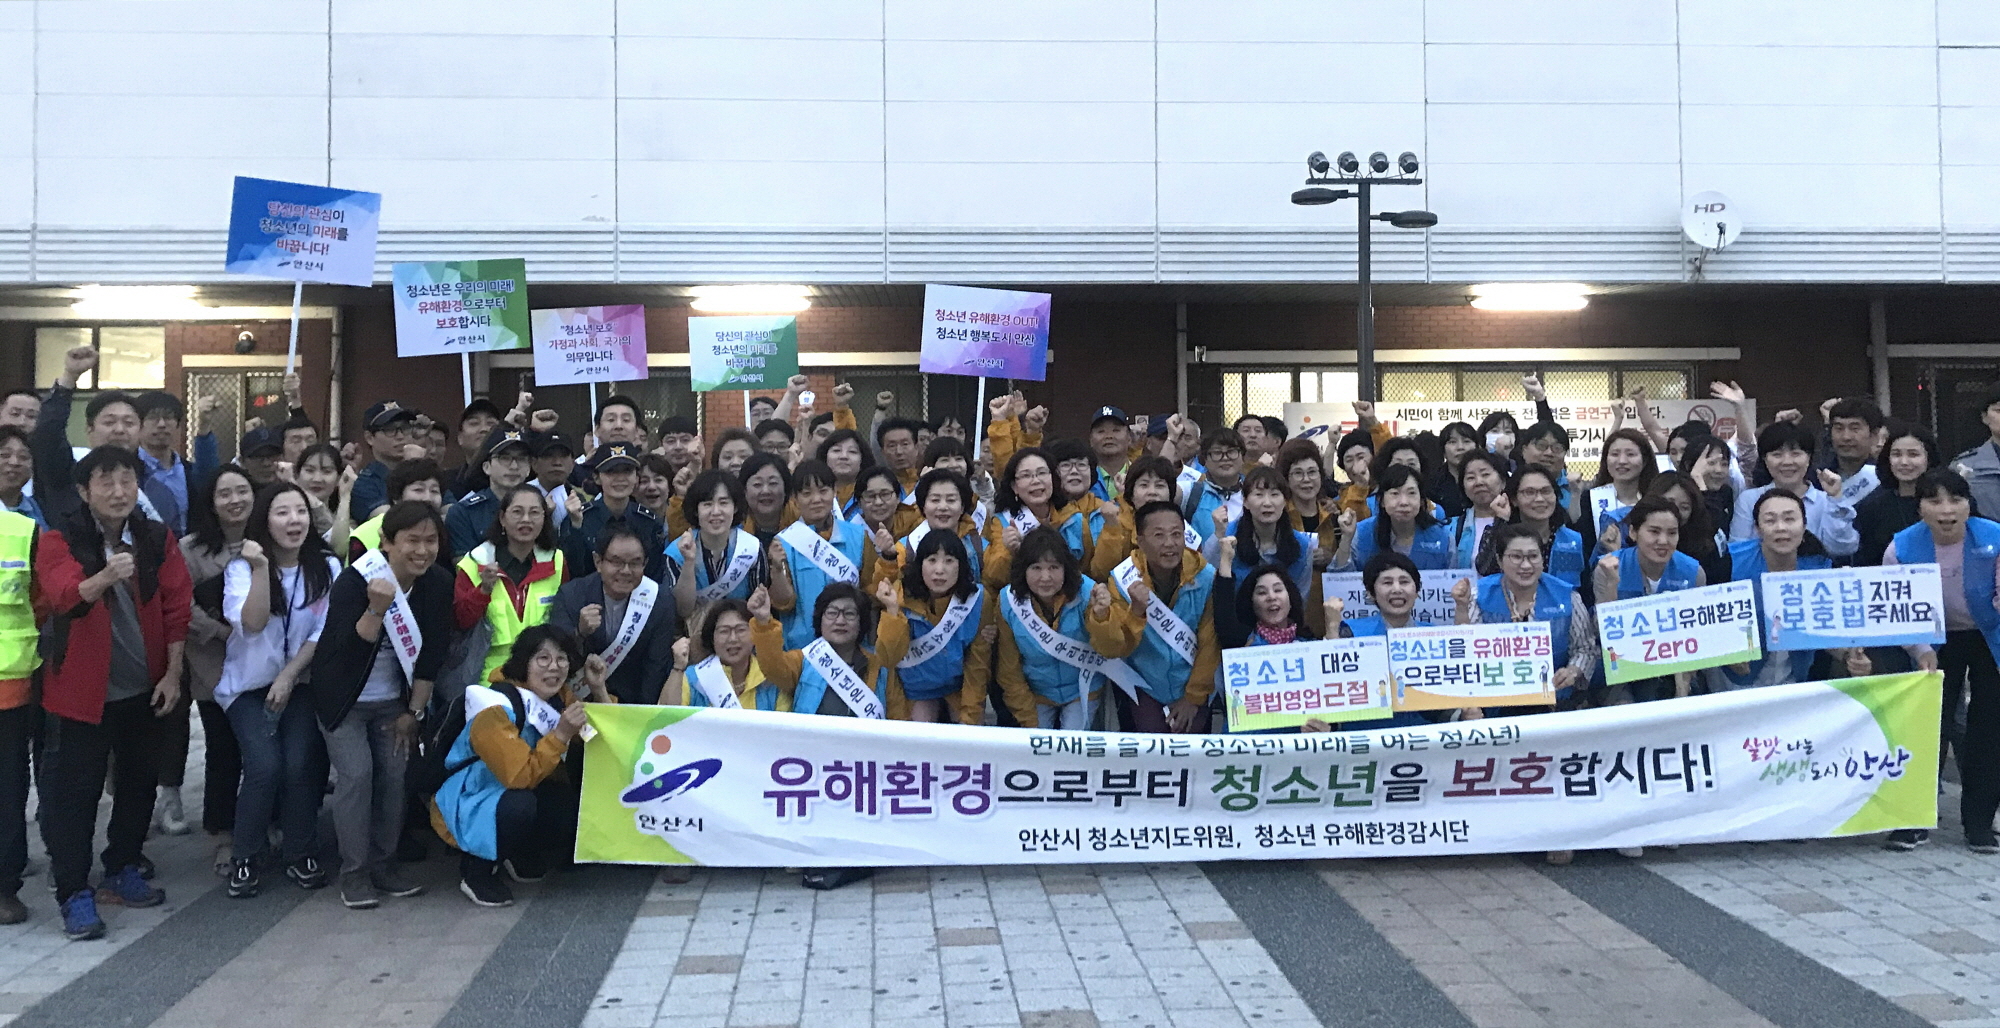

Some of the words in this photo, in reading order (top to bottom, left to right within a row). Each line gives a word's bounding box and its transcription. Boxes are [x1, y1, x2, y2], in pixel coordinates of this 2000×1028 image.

[268, 202, 305, 218] 당신의
[308, 207, 345, 223] 관심이
[1694, 203, 1726, 213] HD
[260, 218, 309, 236] 청소년의
[313, 226, 348, 241] 미래를
[276, 240, 330, 255] 바꿉니다!
[294, 260, 324, 271] 안산시
[407, 283, 452, 298] 청소년은
[454, 280, 487, 294] 우리의
[489, 279, 515, 292] 미래!
[418, 297, 506, 314] 유해환경으로부터
[436, 315, 491, 329] 보호합시다
[935, 308, 967, 323] 청소년
[968, 312, 1010, 326] 유해환경
[1013, 316, 1039, 328] OUT!
[458, 335, 485, 344] 안산시
[549, 339, 577, 350] 가정과
[604, 336, 631, 346] 국가의
[715, 331, 742, 342] 당신의
[744, 330, 771, 340] 관심이
[936, 327, 968, 341] 청소년
[970, 329, 1012, 345] 행복도시
[1014, 332, 1035, 346] 안산
[712, 344, 747, 355] 청소년의
[586, 366, 609, 374] 안산시
[977, 358, 1004, 369] 안산시
[1396, 408, 1433, 421] 시민이
[1437, 408, 1463, 421] 함께
[1467, 408, 1517, 421] 사용
[1575, 406, 1665, 420] 금연구입다.
[1780, 578, 1862, 606] 청소년
[1869, 580, 1912, 602] 지켜
[1779, 604, 1866, 632] 보호법
[1867, 601, 1934, 625] 주세요
[1390, 637, 1466, 662] 청소년을
[1473, 635, 1551, 659] 유해환경
[1642, 637, 1699, 662] Zero
[1228, 656, 1305, 688] 청소년
[1321, 652, 1360, 674] 대상
[1381, 733, 1430, 751] 여는
[1845, 748, 1910, 780] 안산
[763, 757, 1189, 817] 유해환경으로부터
[1211, 760, 1428, 812] 청소년을
[1443, 743, 1713, 797] 보호합시다!
[639, 814, 703, 832] 안산시
[1018, 827, 1080, 851] 안산시
[1088, 825, 1241, 851] 청소년지도위원,
[1255, 824, 1316, 848] 청소년
[1323, 820, 1470, 846] 유해환경감시단
